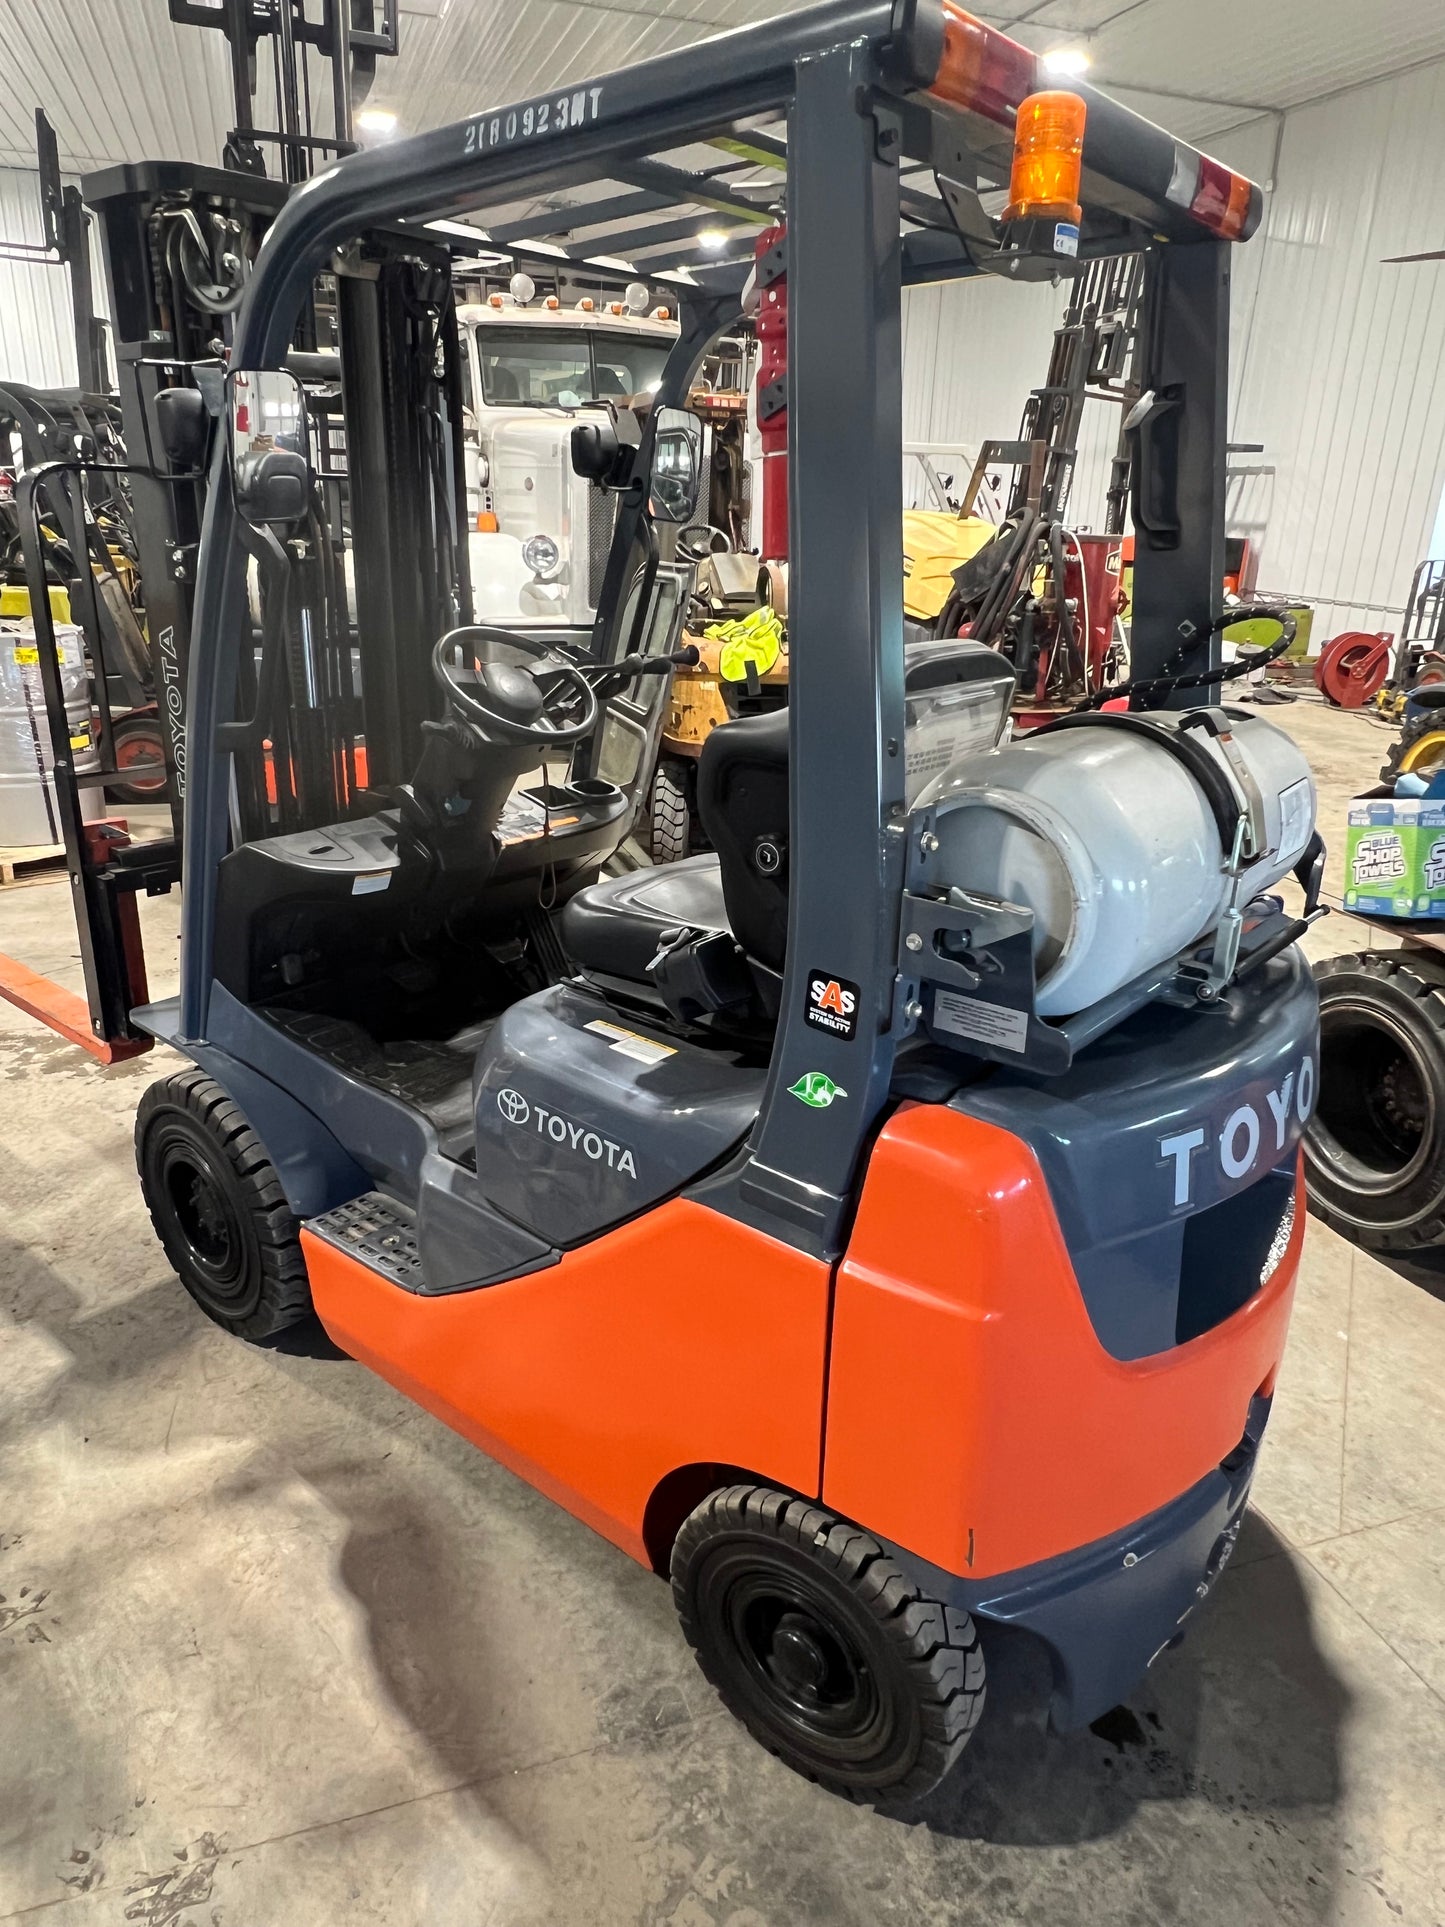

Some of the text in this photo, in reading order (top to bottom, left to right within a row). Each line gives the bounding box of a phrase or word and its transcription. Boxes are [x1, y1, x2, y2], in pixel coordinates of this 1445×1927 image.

[1357, 841, 1402, 866] SHOP
[1372, 836, 1399, 848] BLUE
[1352, 860, 1405, 885] TOWELS
[811, 980, 855, 1016] SAS
[809, 1012, 850, 1033] STABILITY
[534, 1106, 637, 1180] TOYOTA
